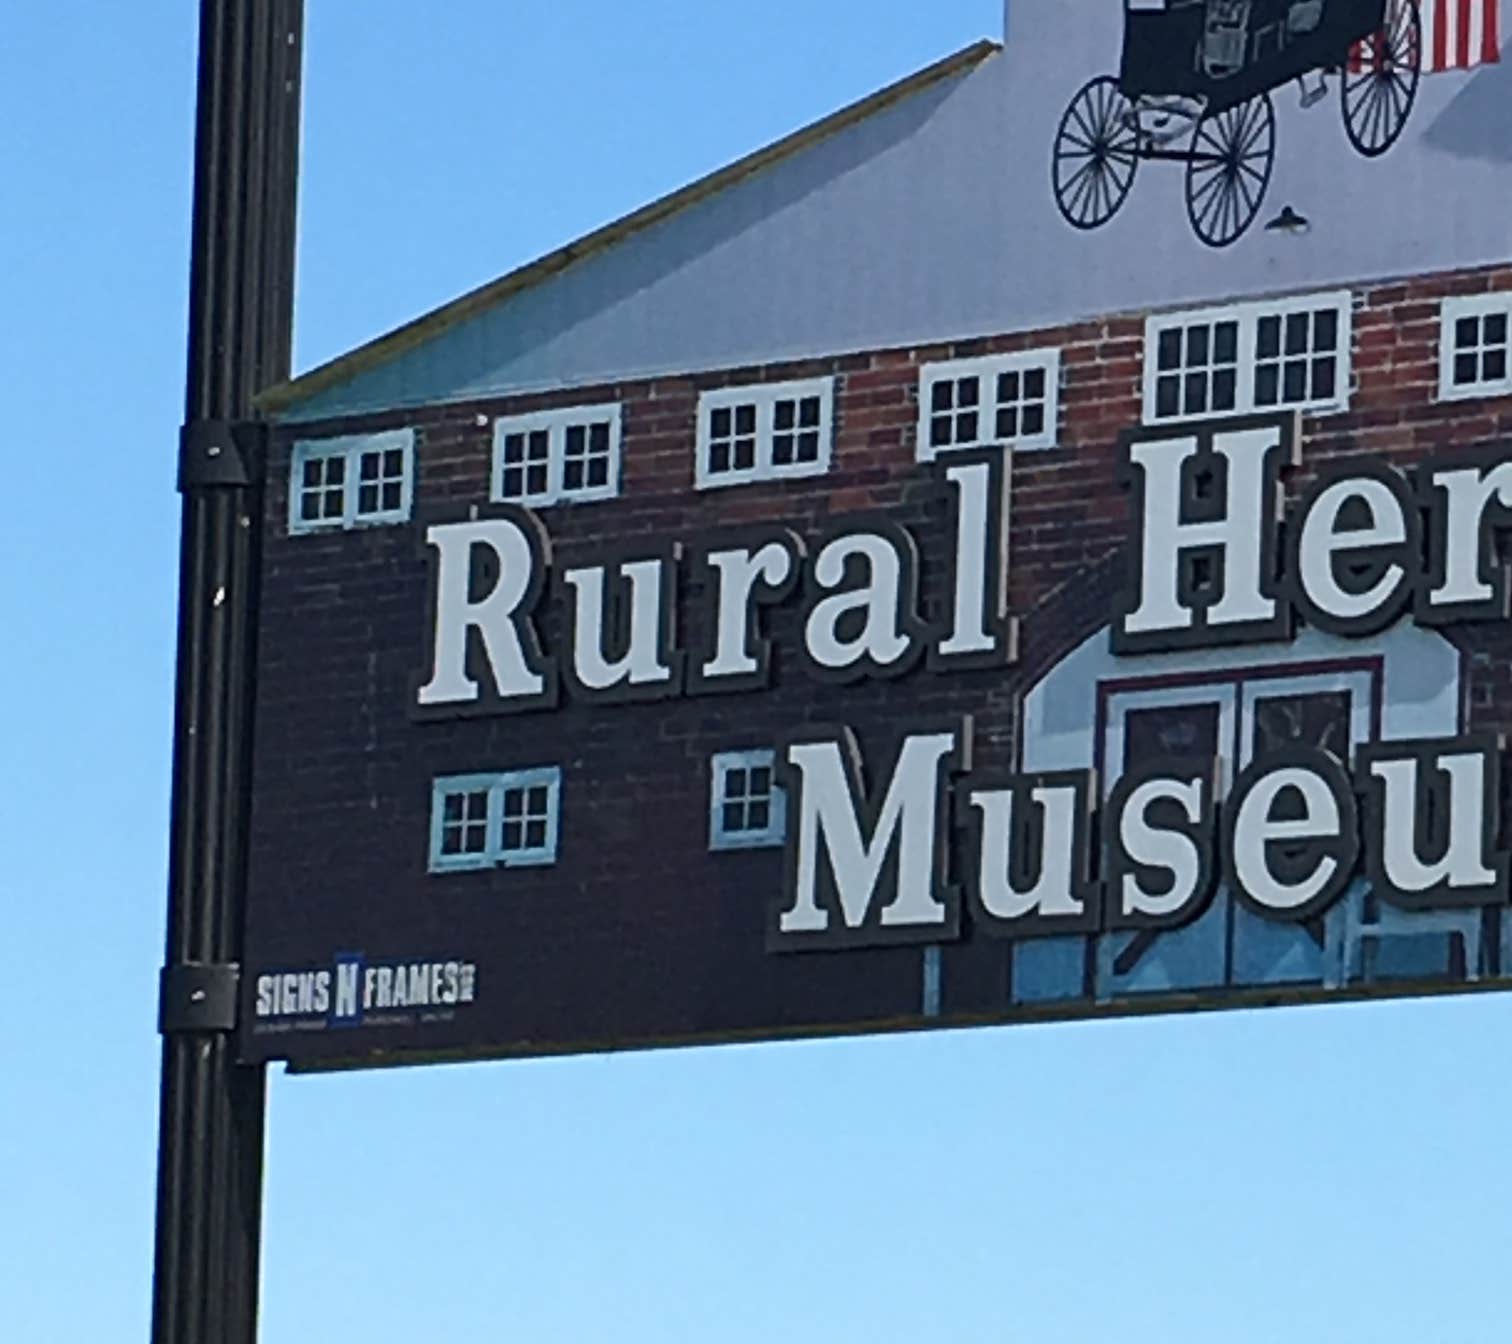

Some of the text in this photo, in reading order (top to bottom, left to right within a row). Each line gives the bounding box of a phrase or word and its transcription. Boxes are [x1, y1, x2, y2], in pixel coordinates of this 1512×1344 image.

[418, 460, 996, 704] Rural
[256, 970, 331, 1016] SIGNS
[335, 962, 359, 1017] N
[362, 960, 459, 1010] FRAMES
